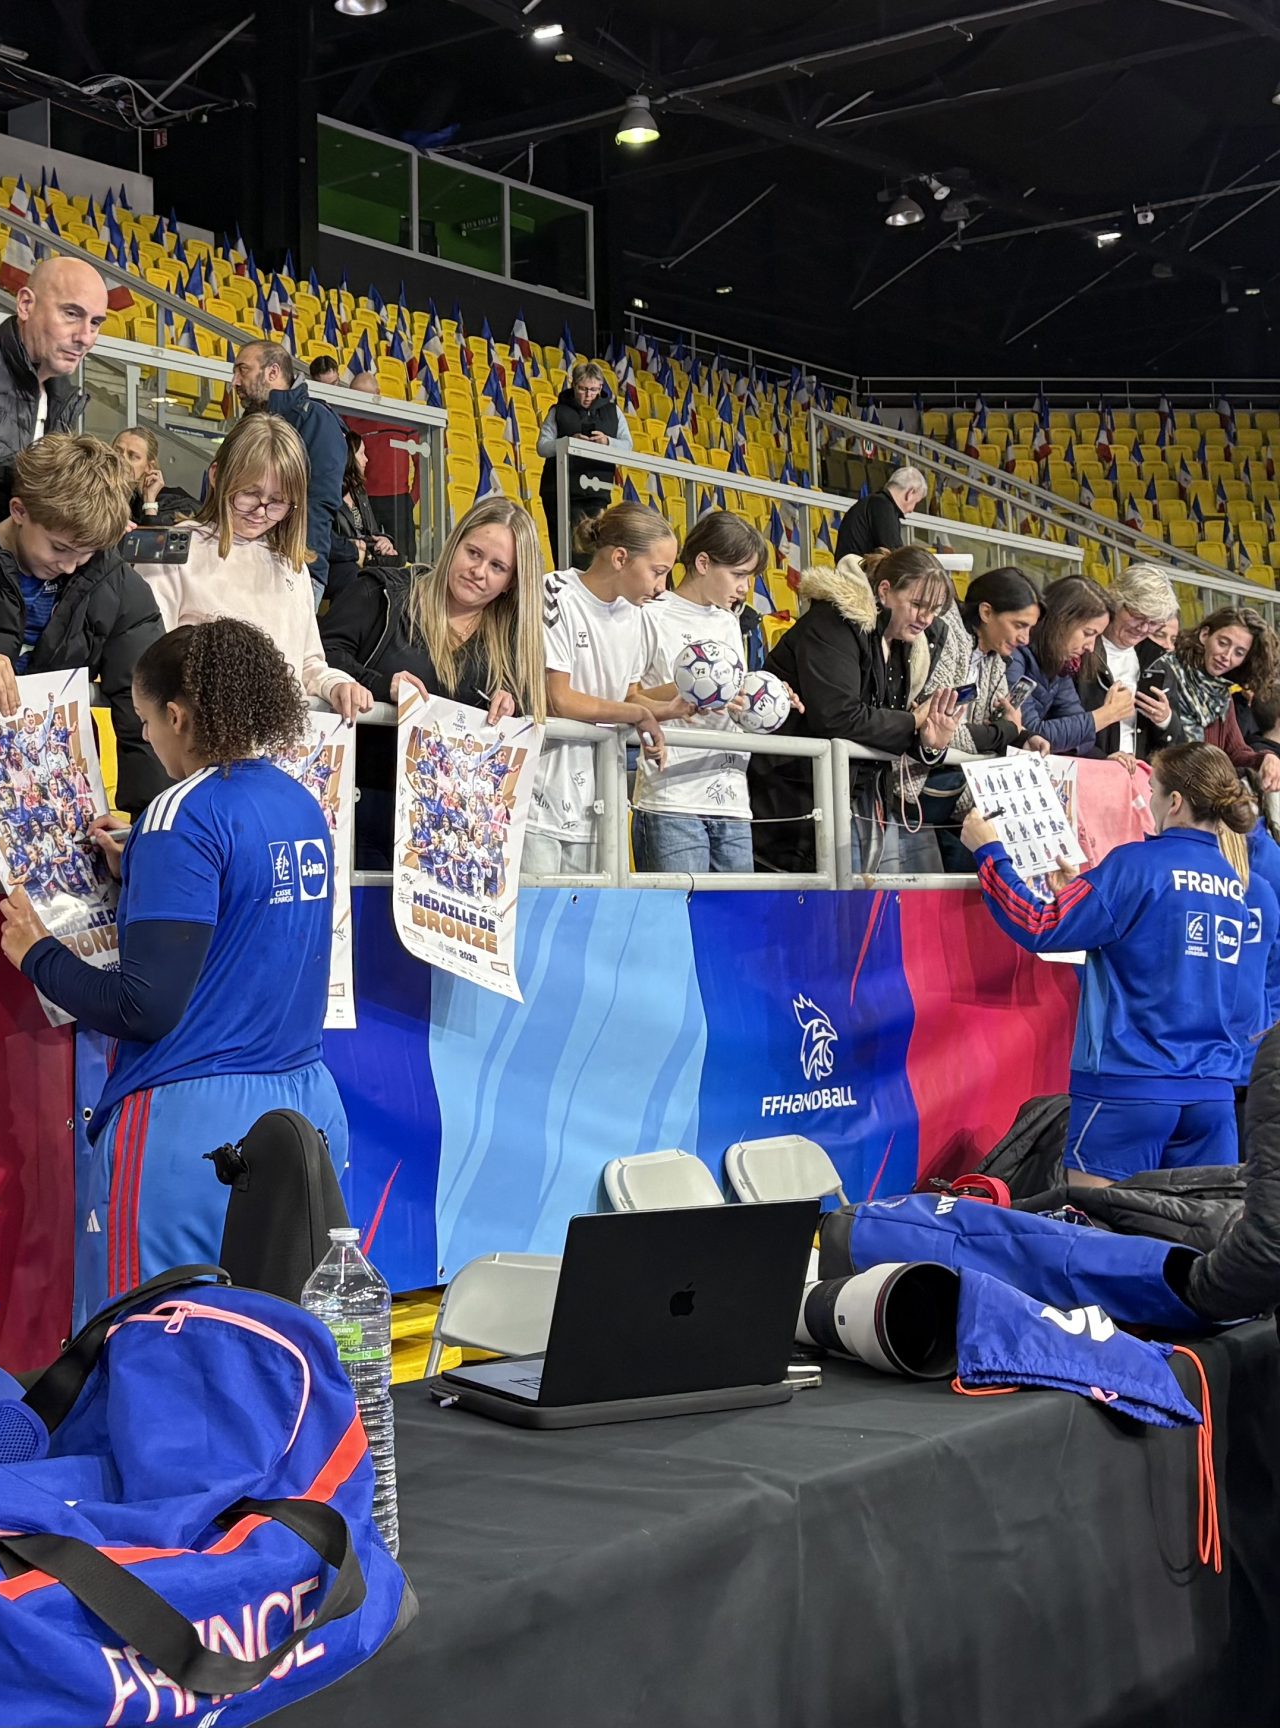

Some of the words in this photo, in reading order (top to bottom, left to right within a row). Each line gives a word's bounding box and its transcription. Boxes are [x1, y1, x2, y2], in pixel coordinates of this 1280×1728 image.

[411, 903, 498, 955] BRONZE
[413, 891, 477, 926] MÉDAILLE
[479, 915, 496, 933] DE
[458, 949, 478, 964] 2025
